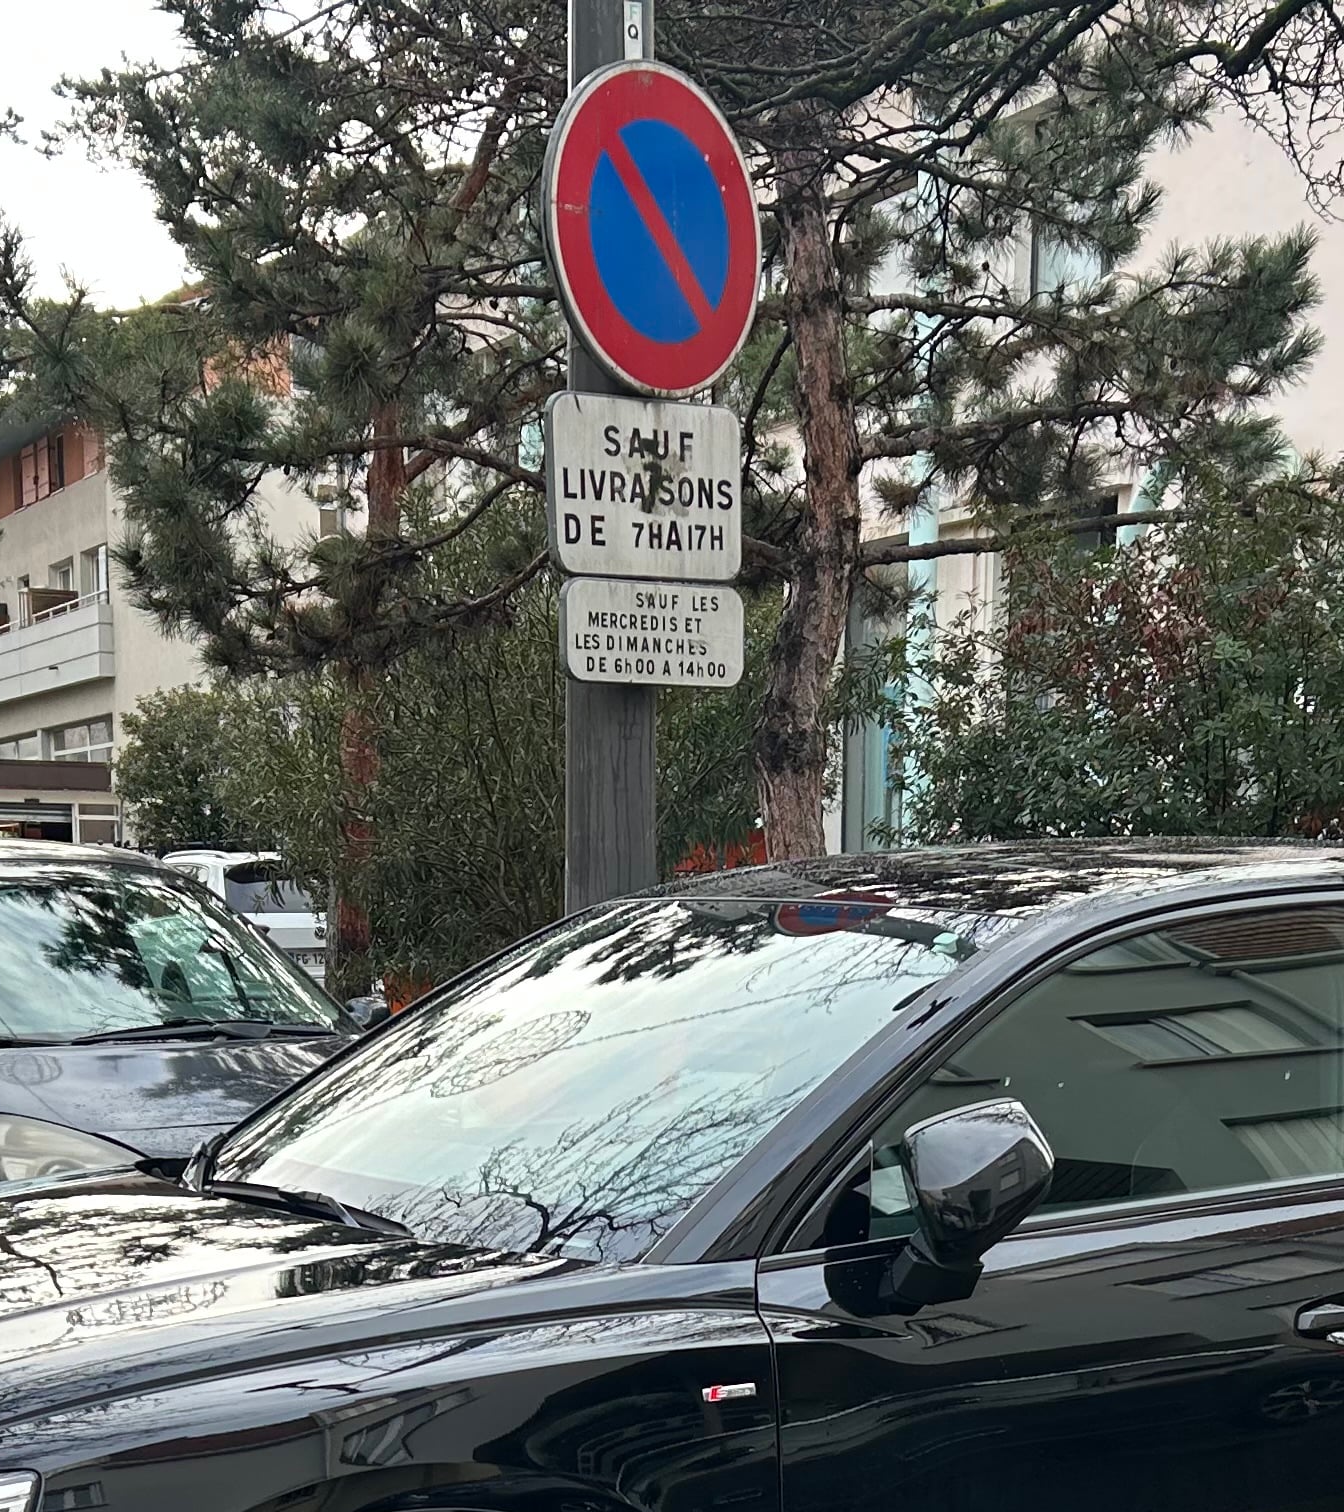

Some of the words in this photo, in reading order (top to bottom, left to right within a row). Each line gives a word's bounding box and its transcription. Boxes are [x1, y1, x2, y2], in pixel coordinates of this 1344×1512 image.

[604, 425, 694, 462] SAUF
[562, 466, 734, 511] LIVRAISONS
[564, 513, 606, 547] DE
[636, 592, 680, 611] SAUF
[692, 596, 719, 612] LES
[588, 611, 678, 633] MERCREDIS
[685, 617, 702, 634] ET
[575, 633, 601, 650] LES
[606, 635, 708, 656] DIMANCHES
[586, 656, 607, 673] DE
[614, 658, 656, 675] 6h00
[662, 660, 672, 676] A
[678, 661, 726, 678] 14h00
